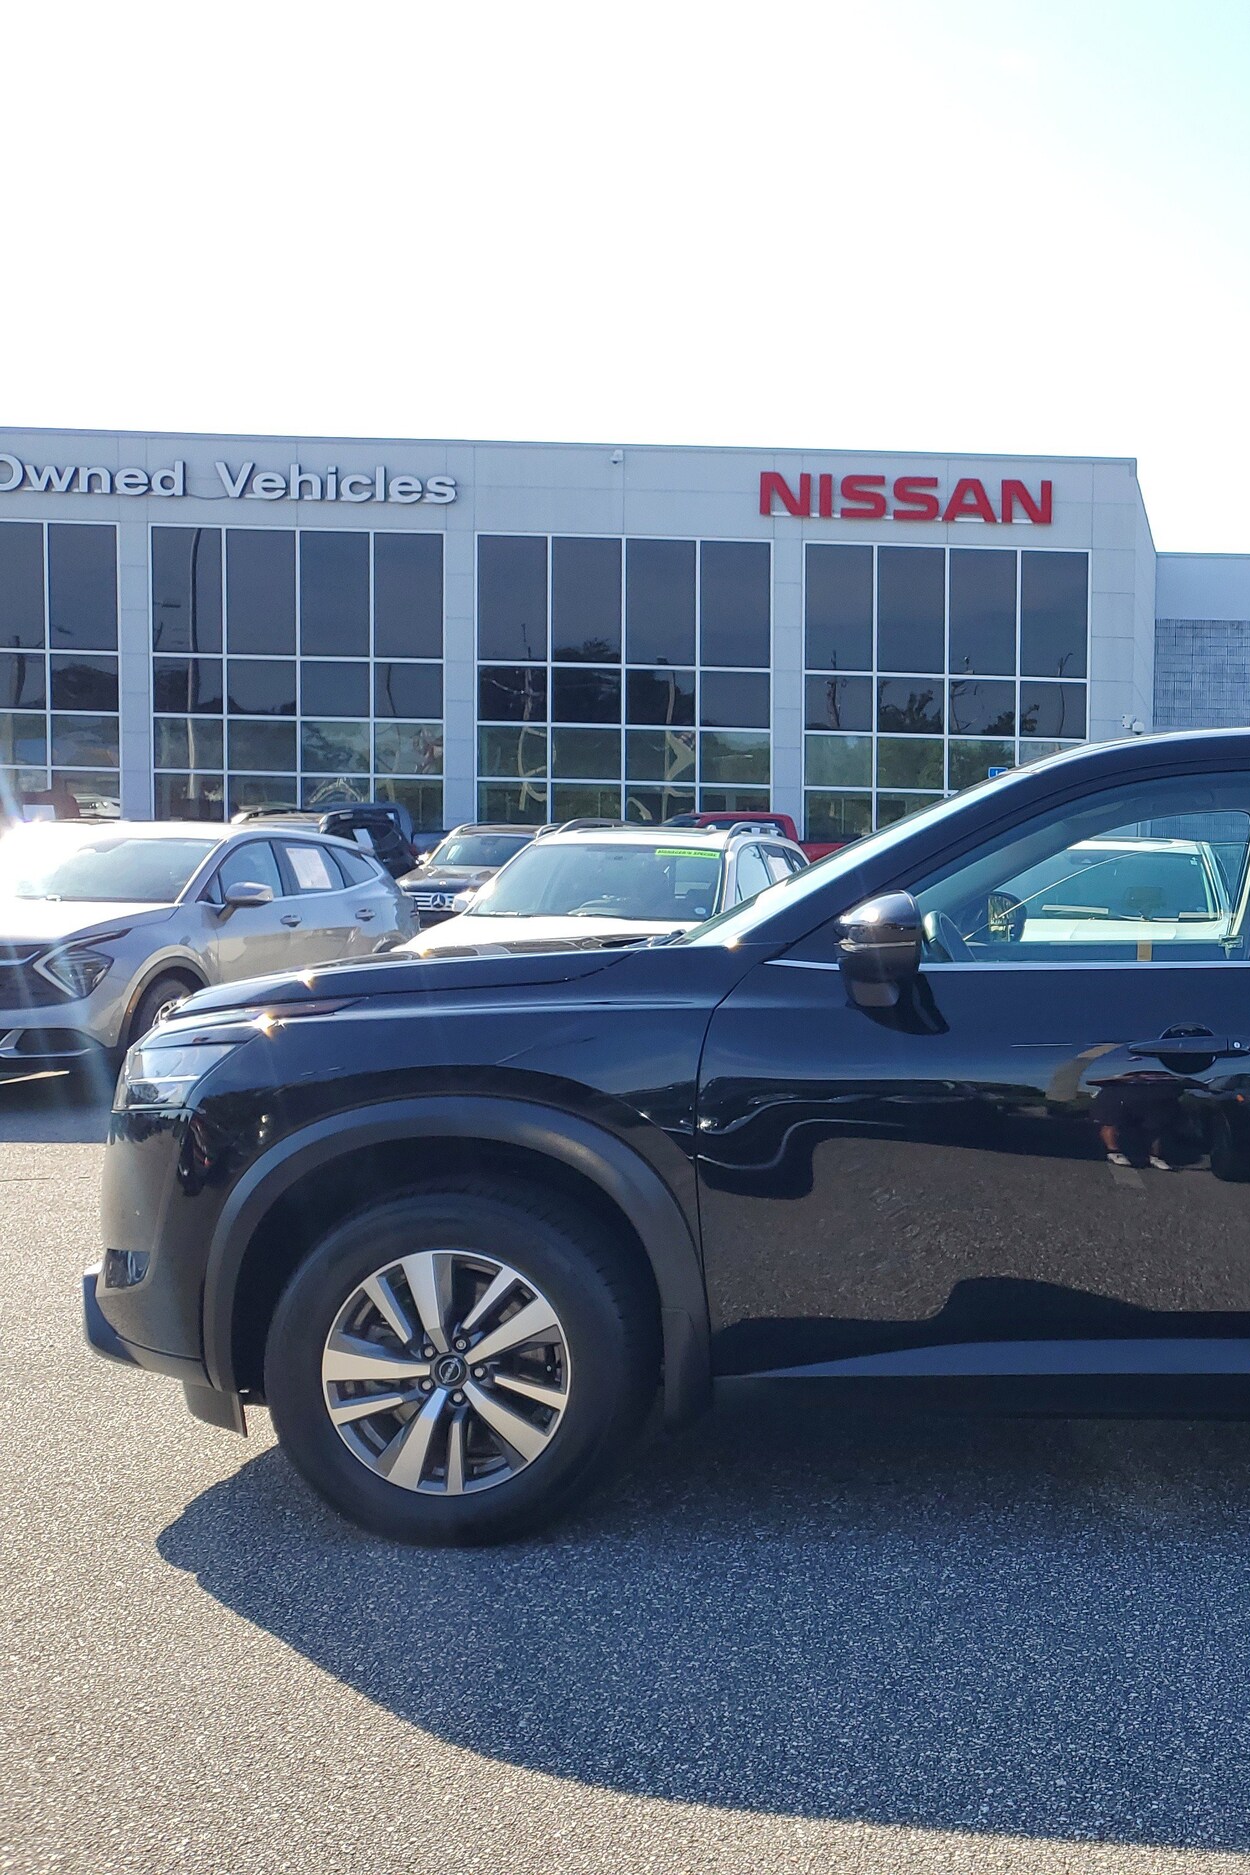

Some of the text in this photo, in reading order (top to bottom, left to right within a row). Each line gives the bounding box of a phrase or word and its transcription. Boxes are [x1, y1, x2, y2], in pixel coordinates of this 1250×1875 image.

[0, 453, 457, 505] Owned Vehicles
[759, 471, 1053, 525] NISSAN
